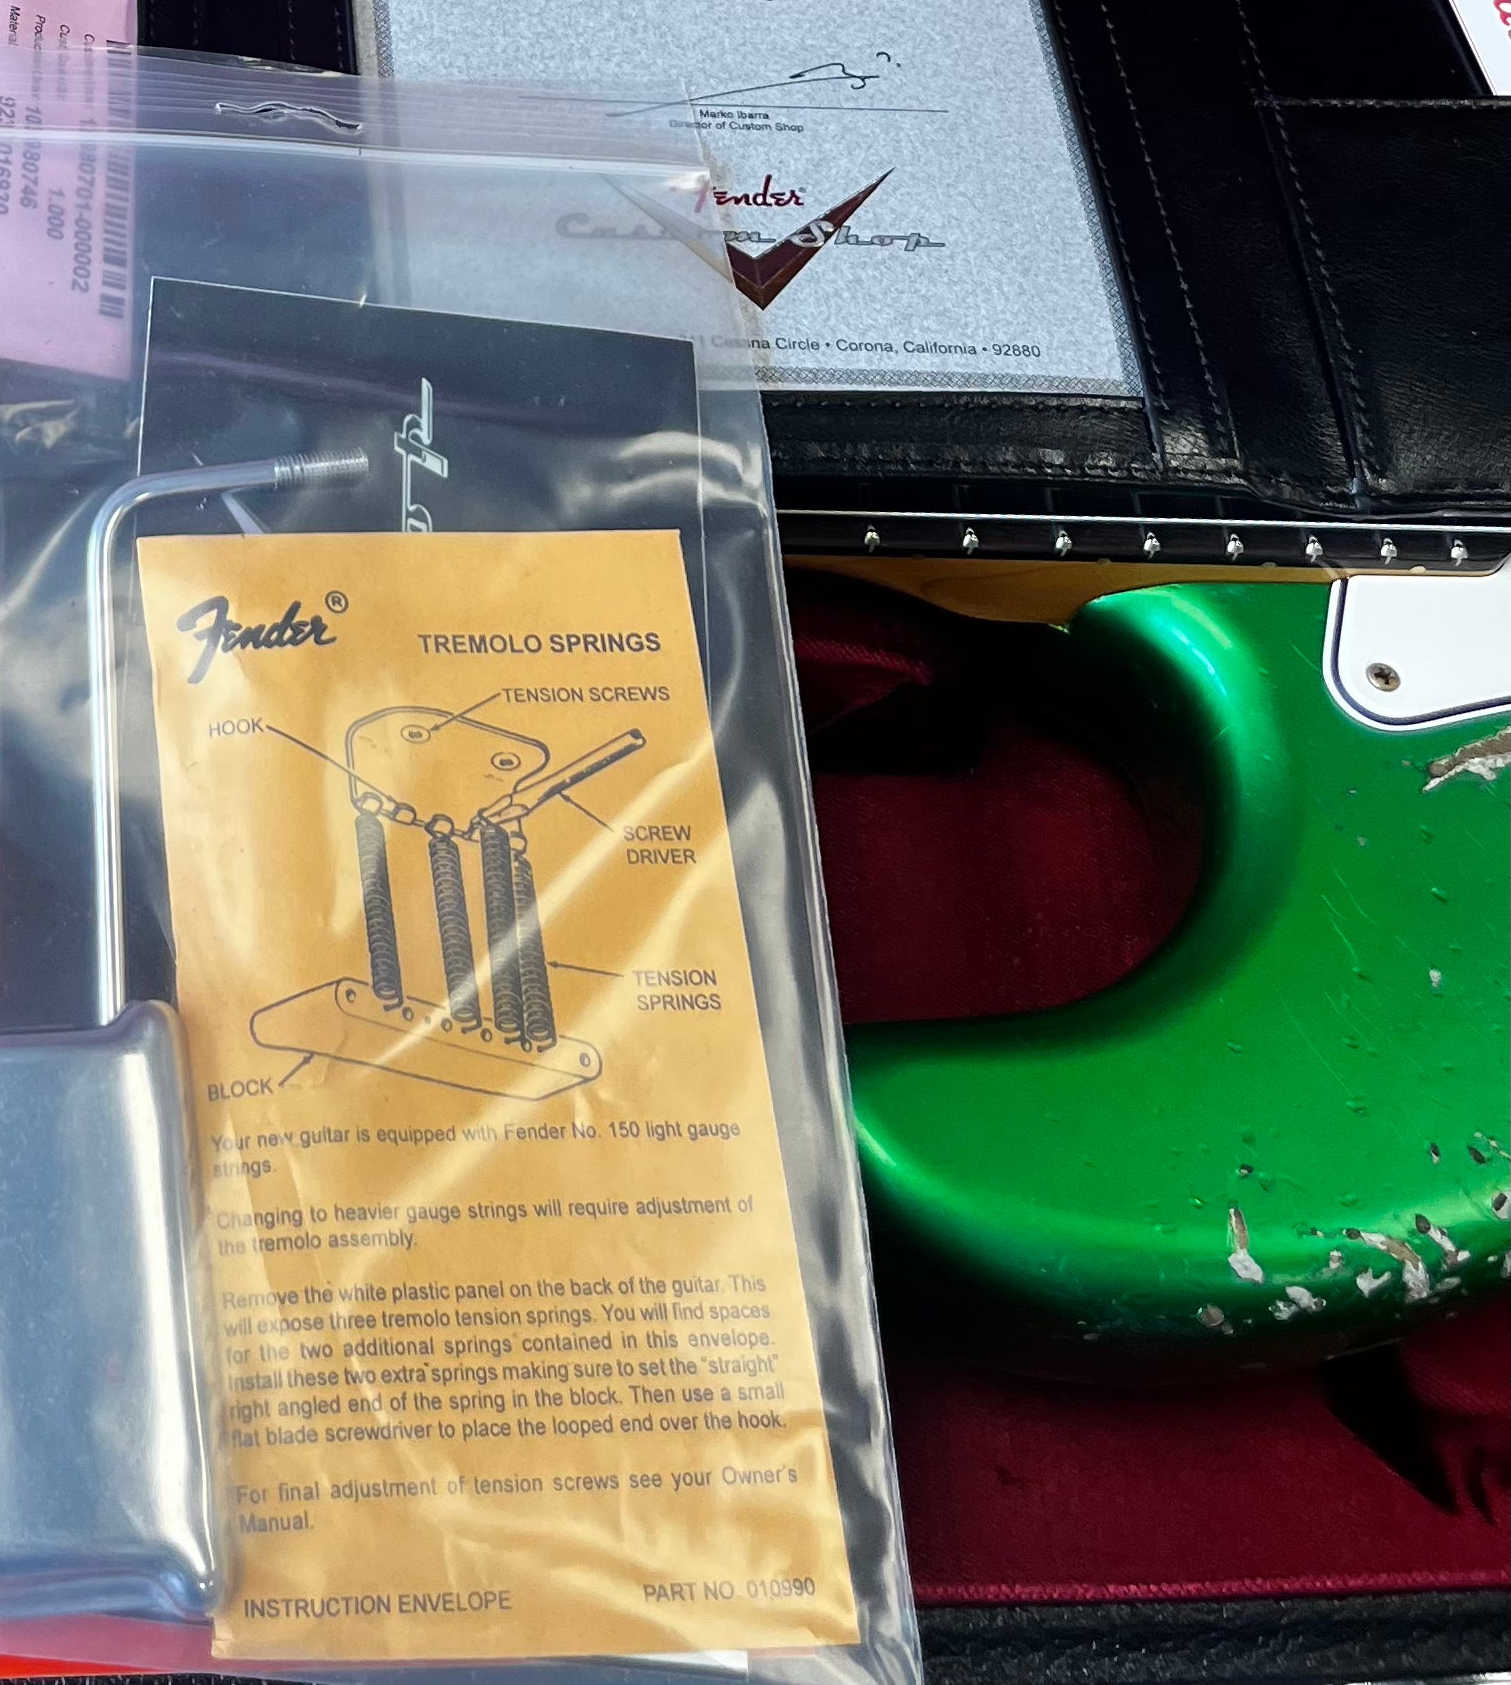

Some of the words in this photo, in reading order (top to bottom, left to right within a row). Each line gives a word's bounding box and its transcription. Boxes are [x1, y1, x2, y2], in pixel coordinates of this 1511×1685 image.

[790, 220, 945, 252] Shop
[771, 337, 819, 352] Circle
[835, 338, 898, 356] Corona,
[902, 340, 977, 355] California
[991, 341, 1040, 357] 92880
[417, 633, 542, 655] TREMOLO
[549, 631, 661, 653] SPRINGS
[501, 686, 583, 703] TENSION
[588, 686, 670, 702] SCREWS
[208, 716, 266, 737] HOOK
[624, 824, 691, 843] SCREW
[624, 847, 696, 866] DRIVER
[632, 969, 717, 986] TENSION
[637, 992, 721, 1011] SPRINGS
[207, 1076, 274, 1101] BLOCK
[210, 1132, 250, 1155] Your
[256, 1130, 294, 1148] new
[296, 1129, 349, 1149] guitar
[356, 1128, 370, 1142] is
[376, 1126, 456, 1146] equipped
[461, 1125, 497, 1141] with
[504, 1123, 566, 1141] Fender
[608, 1121, 640, 1138] 150
[645, 1120, 682, 1141] light
[687, 1122, 740, 1141] gauge
[231, 1428, 260, 1448] flat
[265, 1426, 318, 1445] blade
[324, 1423, 432, 1444] screwdriver
[437, 1421, 455, 1440] to
[461, 1420, 511, 1443] place
[516, 1418, 546, 1436] the
[552, 1415, 613, 1438] looped
[619, 1414, 653, 1432] end
[659, 1415, 698, 1431] over
[703, 1412, 732, 1430] the
[736, 1410, 786, 1429] hook.
[641, 1582, 696, 1603] PART
[746, 1576, 815, 1599] 010990
[243, 1594, 391, 1619] INSTRUCTION
[397, 1590, 512, 1613] ENVELOPE
